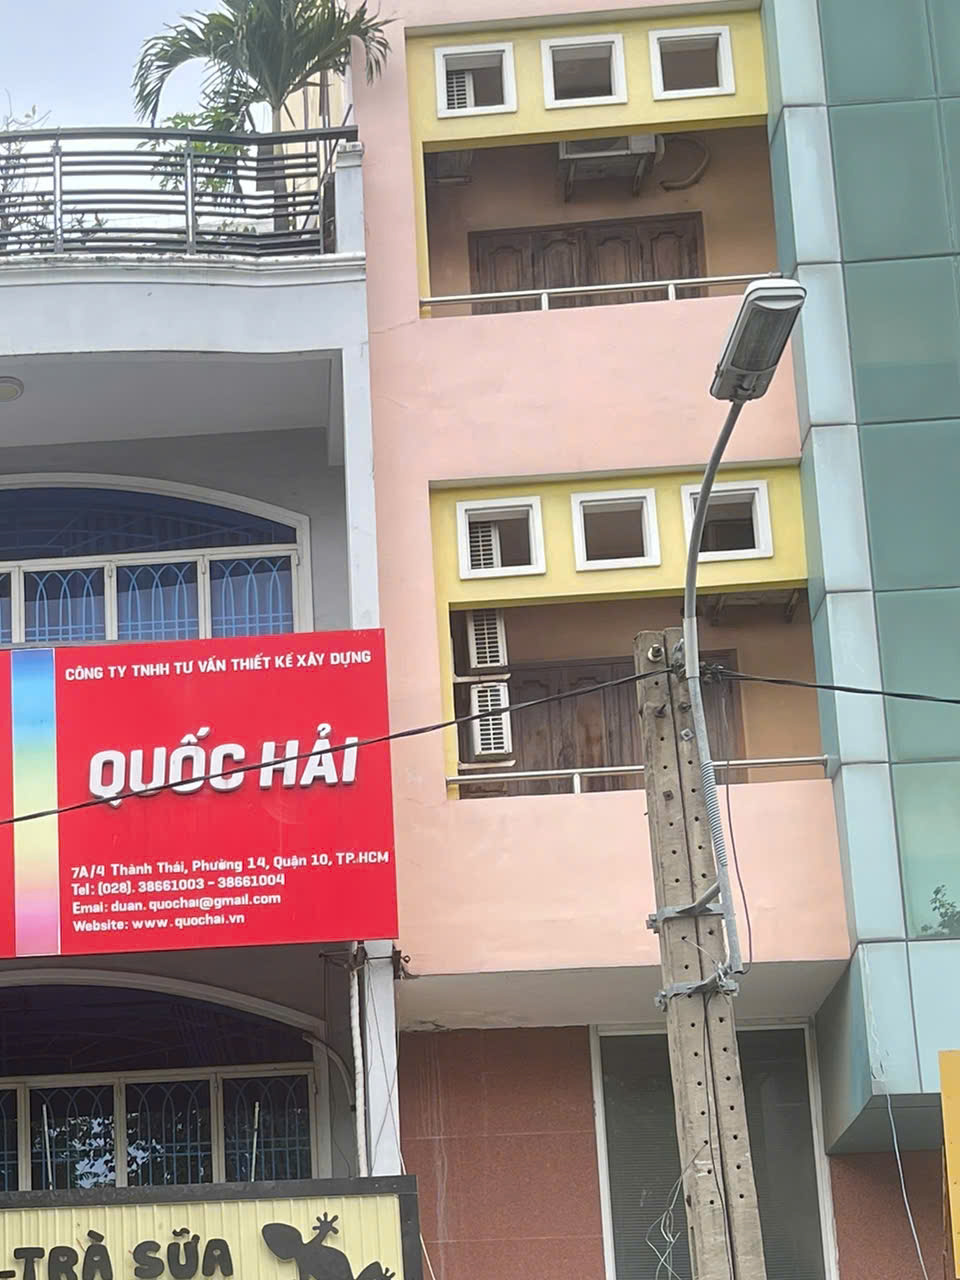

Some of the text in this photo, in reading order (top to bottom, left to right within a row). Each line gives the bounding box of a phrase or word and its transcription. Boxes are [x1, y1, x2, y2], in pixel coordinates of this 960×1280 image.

[65, 650, 371, 681] CÔNG TY TNHH TƯ VẤN THIẾT KẾ XÂY DỰNG
[89, 723, 358, 808] QUỐC HẢI
[72, 864, 105, 879] 7A/4
[111, 862, 152, 877] Thành
[156, 861, 188, 875] Thái,
[247, 856, 269, 871] 14,
[273, 854, 307, 870] Quận
[311, 853, 332, 868] 10,
[336, 851, 389, 865] TP.HCM
[72, 882, 95, 896] Tel:
[138, 878, 204, 893] 38661003
[218, 873, 285, 888] 38661004
[73, 918, 129, 934] Website:
[132, 1227, 235, 1280] SỮA
